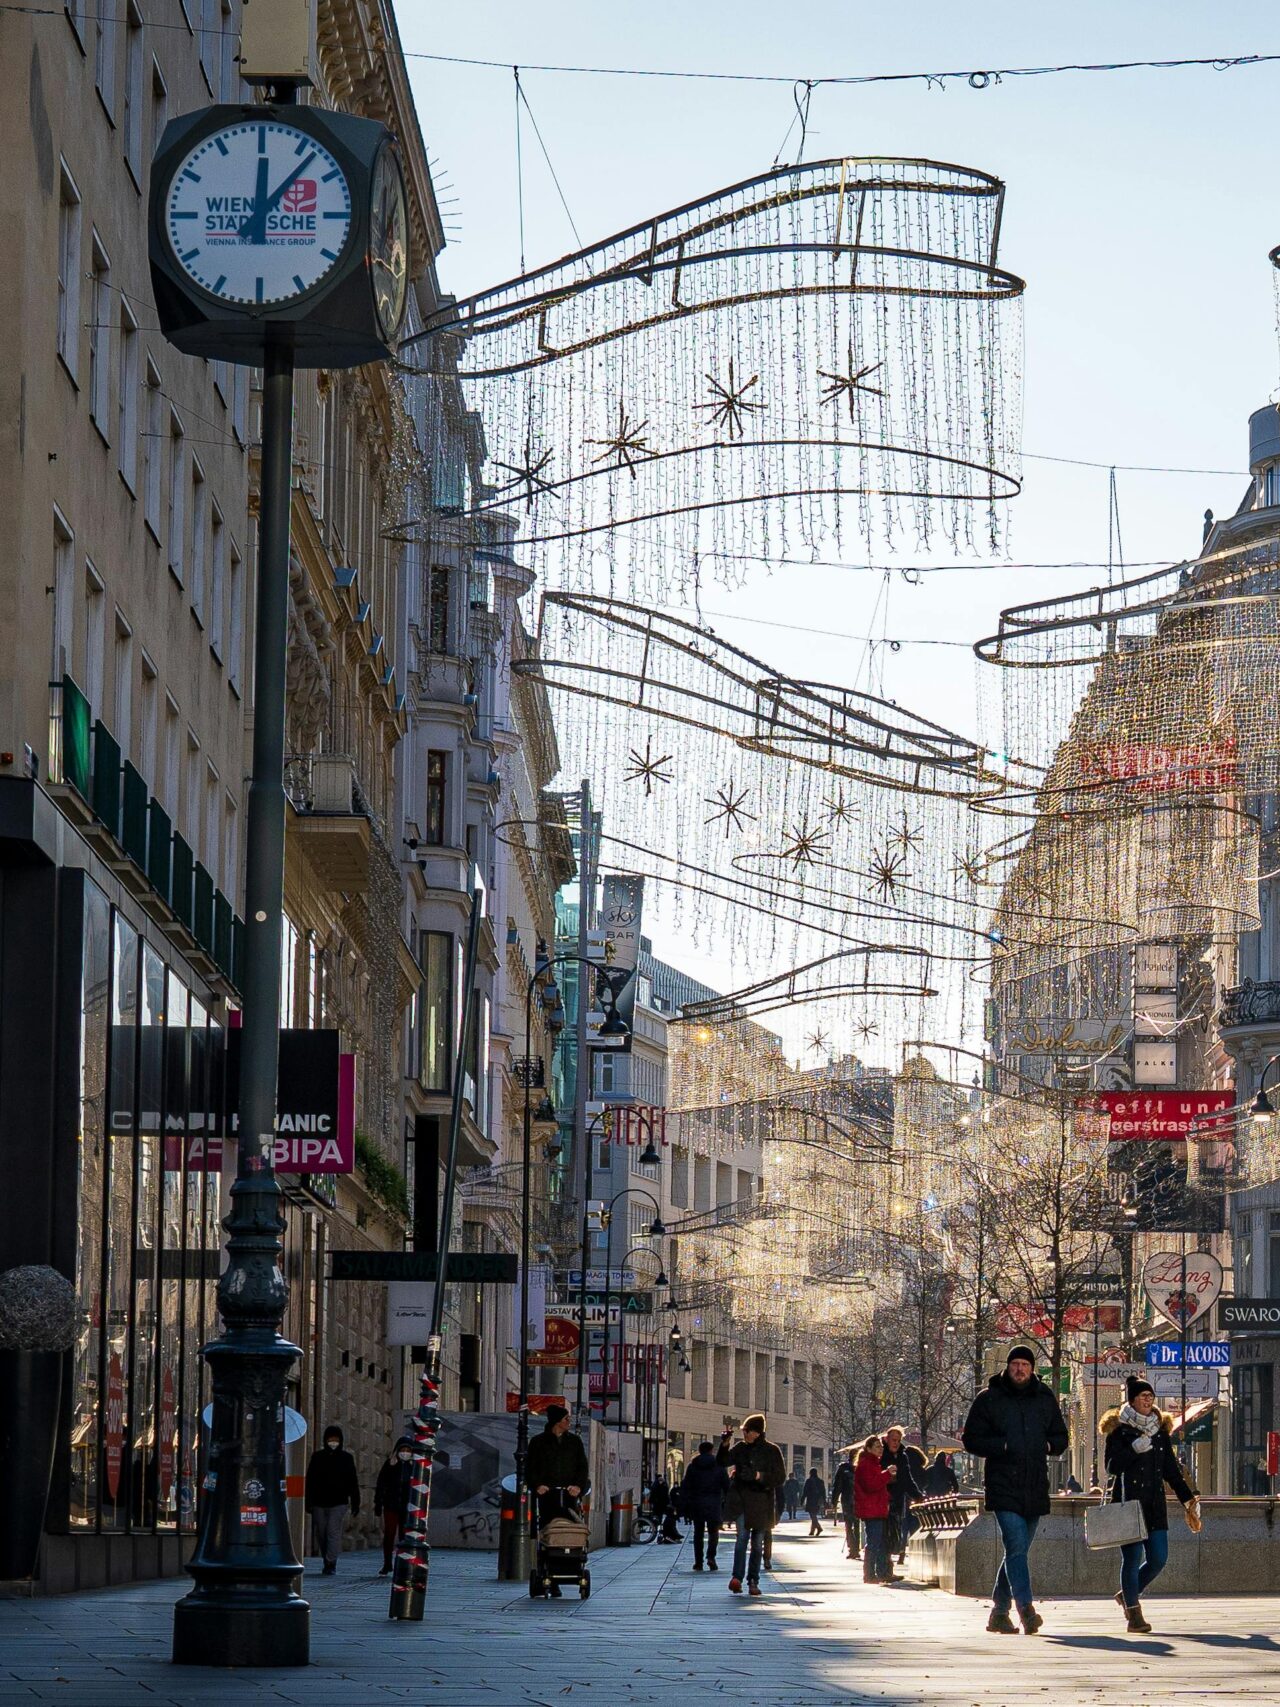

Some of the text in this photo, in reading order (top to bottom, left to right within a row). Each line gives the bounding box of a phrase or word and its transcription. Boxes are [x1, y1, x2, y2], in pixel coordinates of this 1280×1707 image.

[205, 197, 280, 213] WIENR
[205, 214, 317, 230] STÄDSCHE
[205, 238, 316, 246] VIENNA INSANCE GROUP
[606, 930, 635, 940] BAR
[1180, 1100, 1226, 1114] und
[270, 1139, 344, 1165] BIPA
[586, 1271, 609, 1280] MAGI
[1151, 1254, 1214, 1293] Lanz
[572, 1308, 619, 1321] KLIMT
[546, 1335, 576, 1346] UKA
[1089, 1367, 1140, 1379] swatch
[589, 1374, 611, 1388] STEFL
